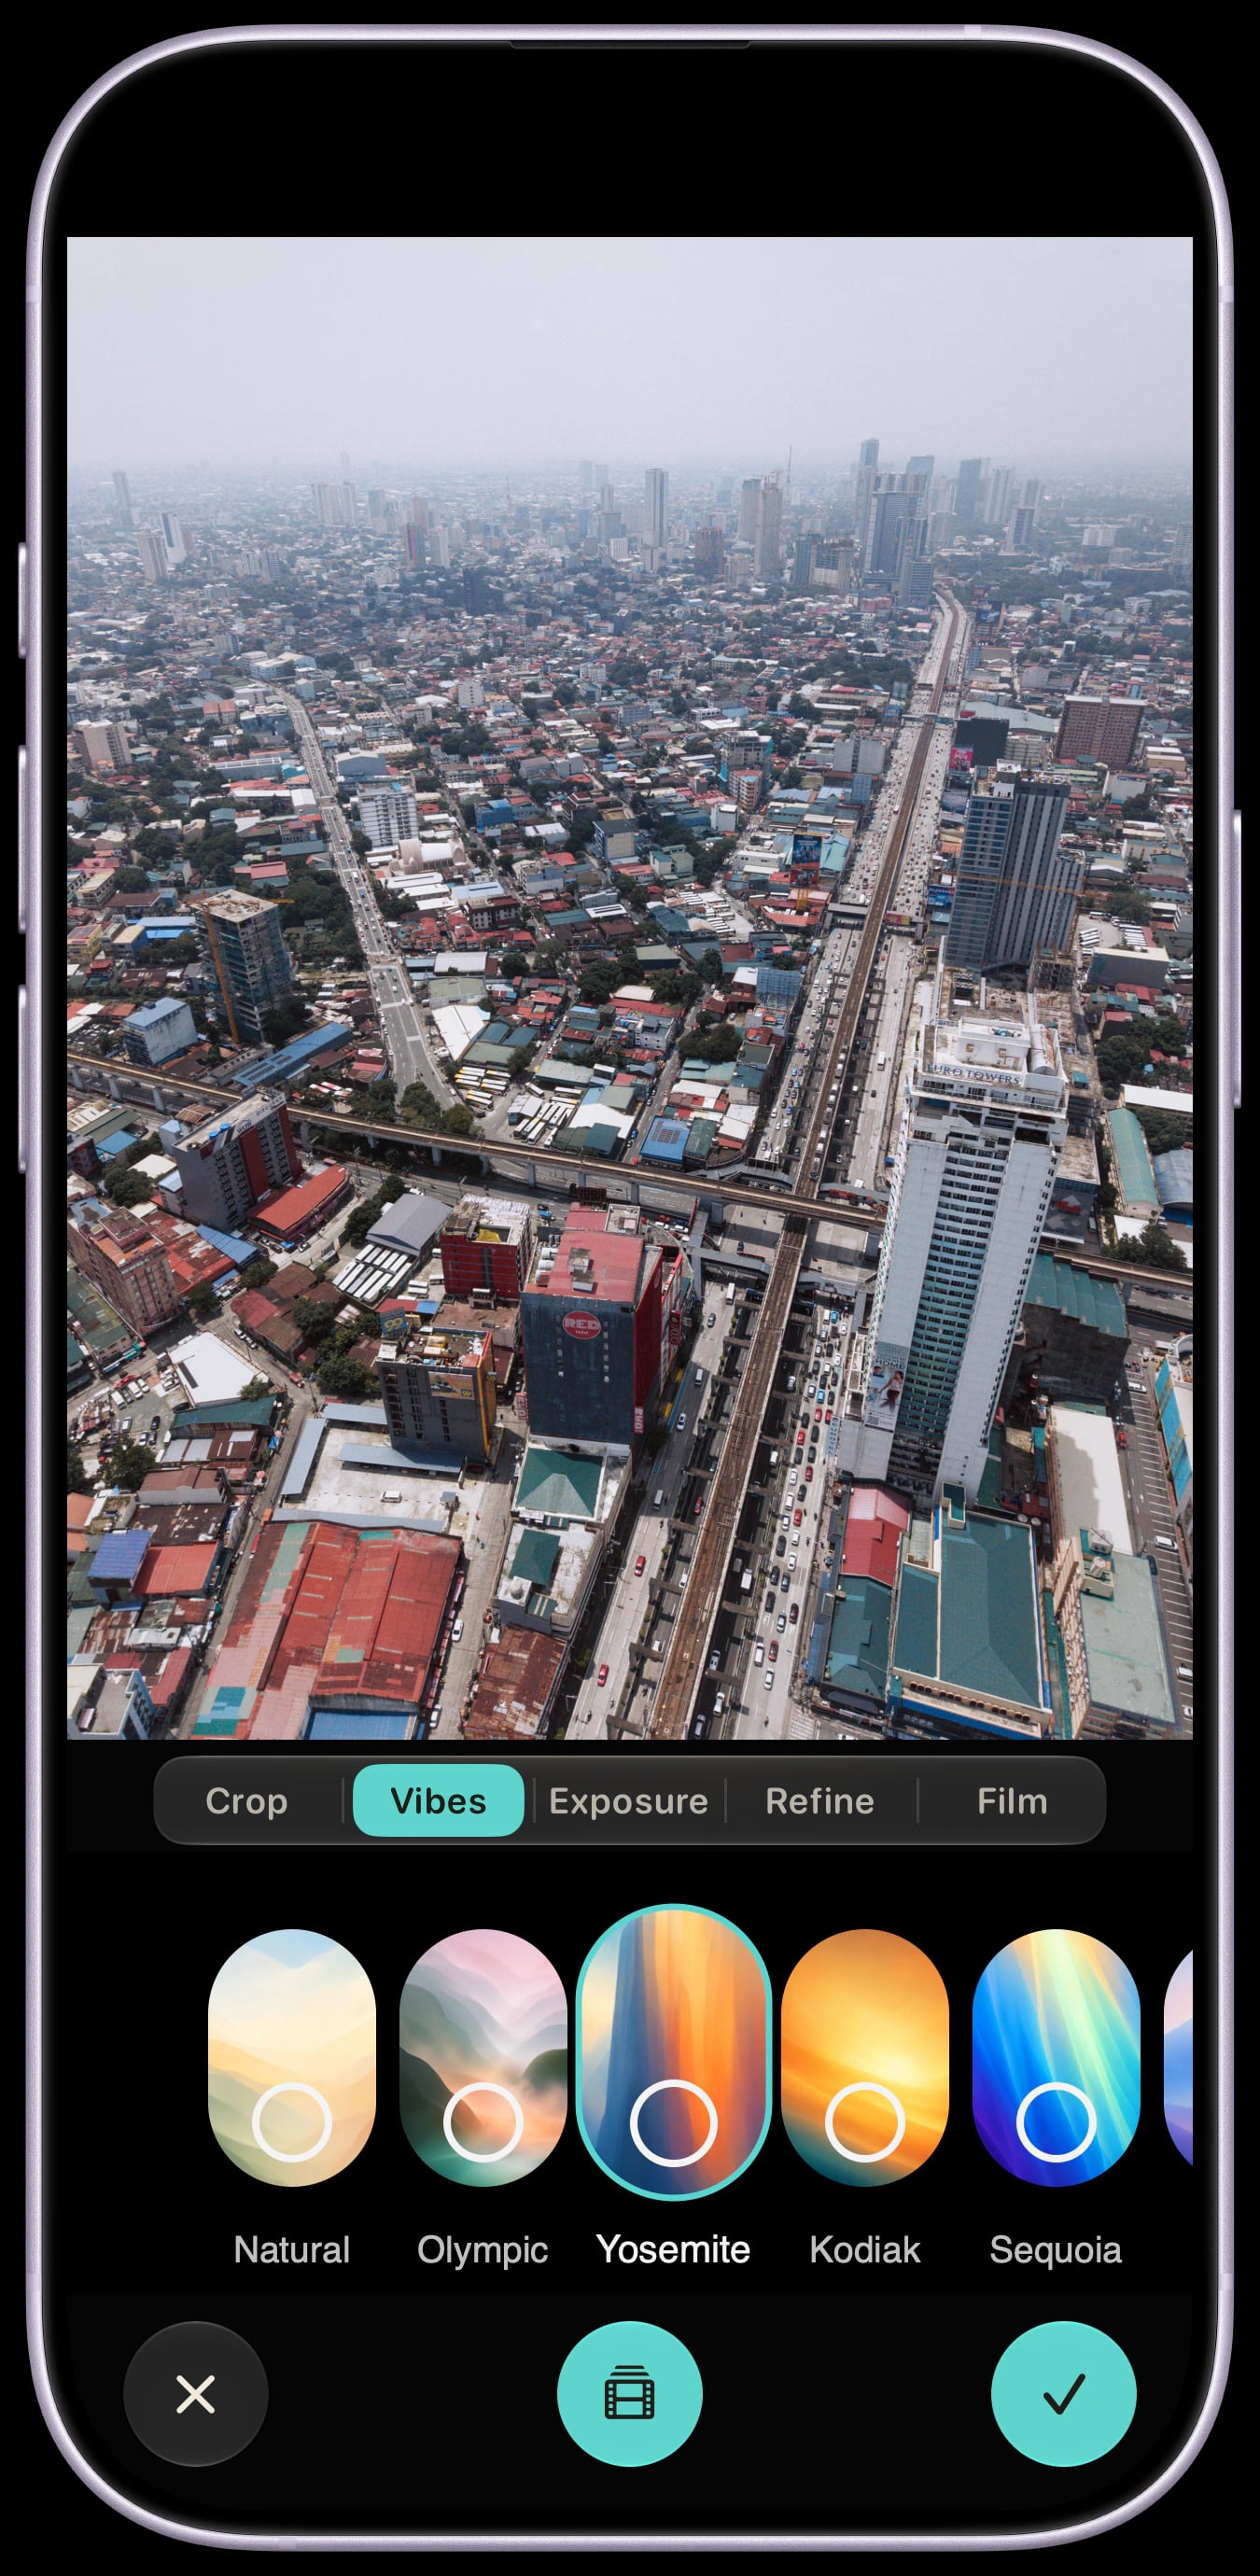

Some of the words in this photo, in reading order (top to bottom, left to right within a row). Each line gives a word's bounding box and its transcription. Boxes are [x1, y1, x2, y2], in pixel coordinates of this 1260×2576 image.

[927, 1063, 963, 1077] EURO
[965, 1069, 1021, 1085] TOWERS
[565, 1318, 600, 1330] RED
[875, 1359, 905, 1370] HOME
[206, 1787, 287, 1820] Crop
[391, 1787, 485, 1813] Vibes
[551, 1787, 707, 1820] Exposure
[767, 1787, 874, 1813] Refine
[979, 1787, 1046, 1813] Film
[236, 2235, 349, 2263] Natural
[418, 2235, 548, 2270] Olympic
[595, 2234, 749, 2263] Yosemite
[812, 2235, 921, 2263] Kodiak
[990, 2235, 1122, 2270] Sequoia
